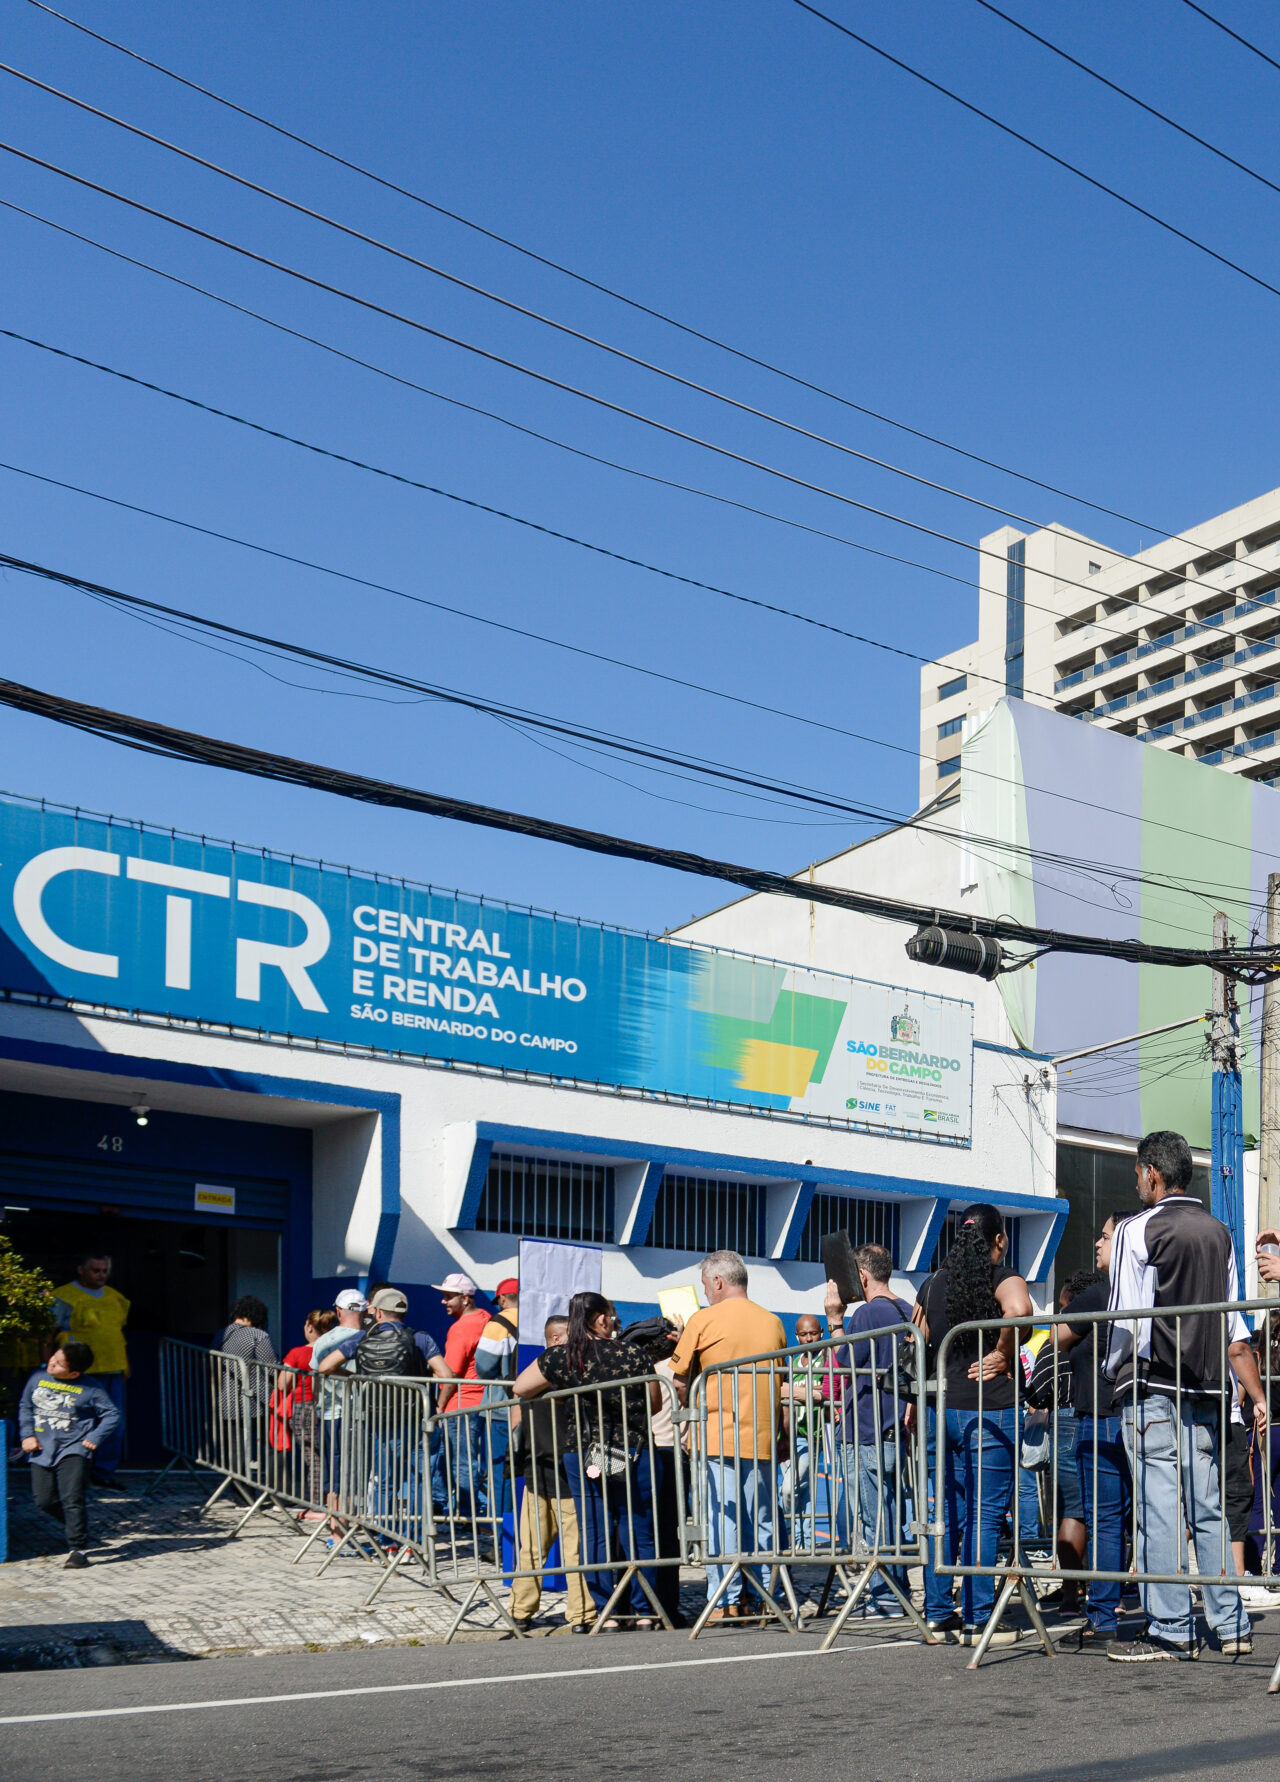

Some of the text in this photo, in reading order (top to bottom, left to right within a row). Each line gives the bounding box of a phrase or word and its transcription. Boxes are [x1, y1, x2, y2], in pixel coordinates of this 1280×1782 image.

[13, 846, 331, 1013] CTR
[352, 905, 511, 959] CENTRAL
[353, 936, 587, 1002] DE TRABALHO
[352, 968, 500, 1019] E RENDA
[350, 1003, 578, 1054] SÃO BERNARDO DO CAMPO
[846, 1040, 961, 1072] SÃO BERNARDO
[866, 1057, 943, 1082] DO CAMPO
[885, 1104, 897, 1112] FAT
[937, 1114, 960, 1124] BRASIL
[97, 1134, 123, 1152] 48
